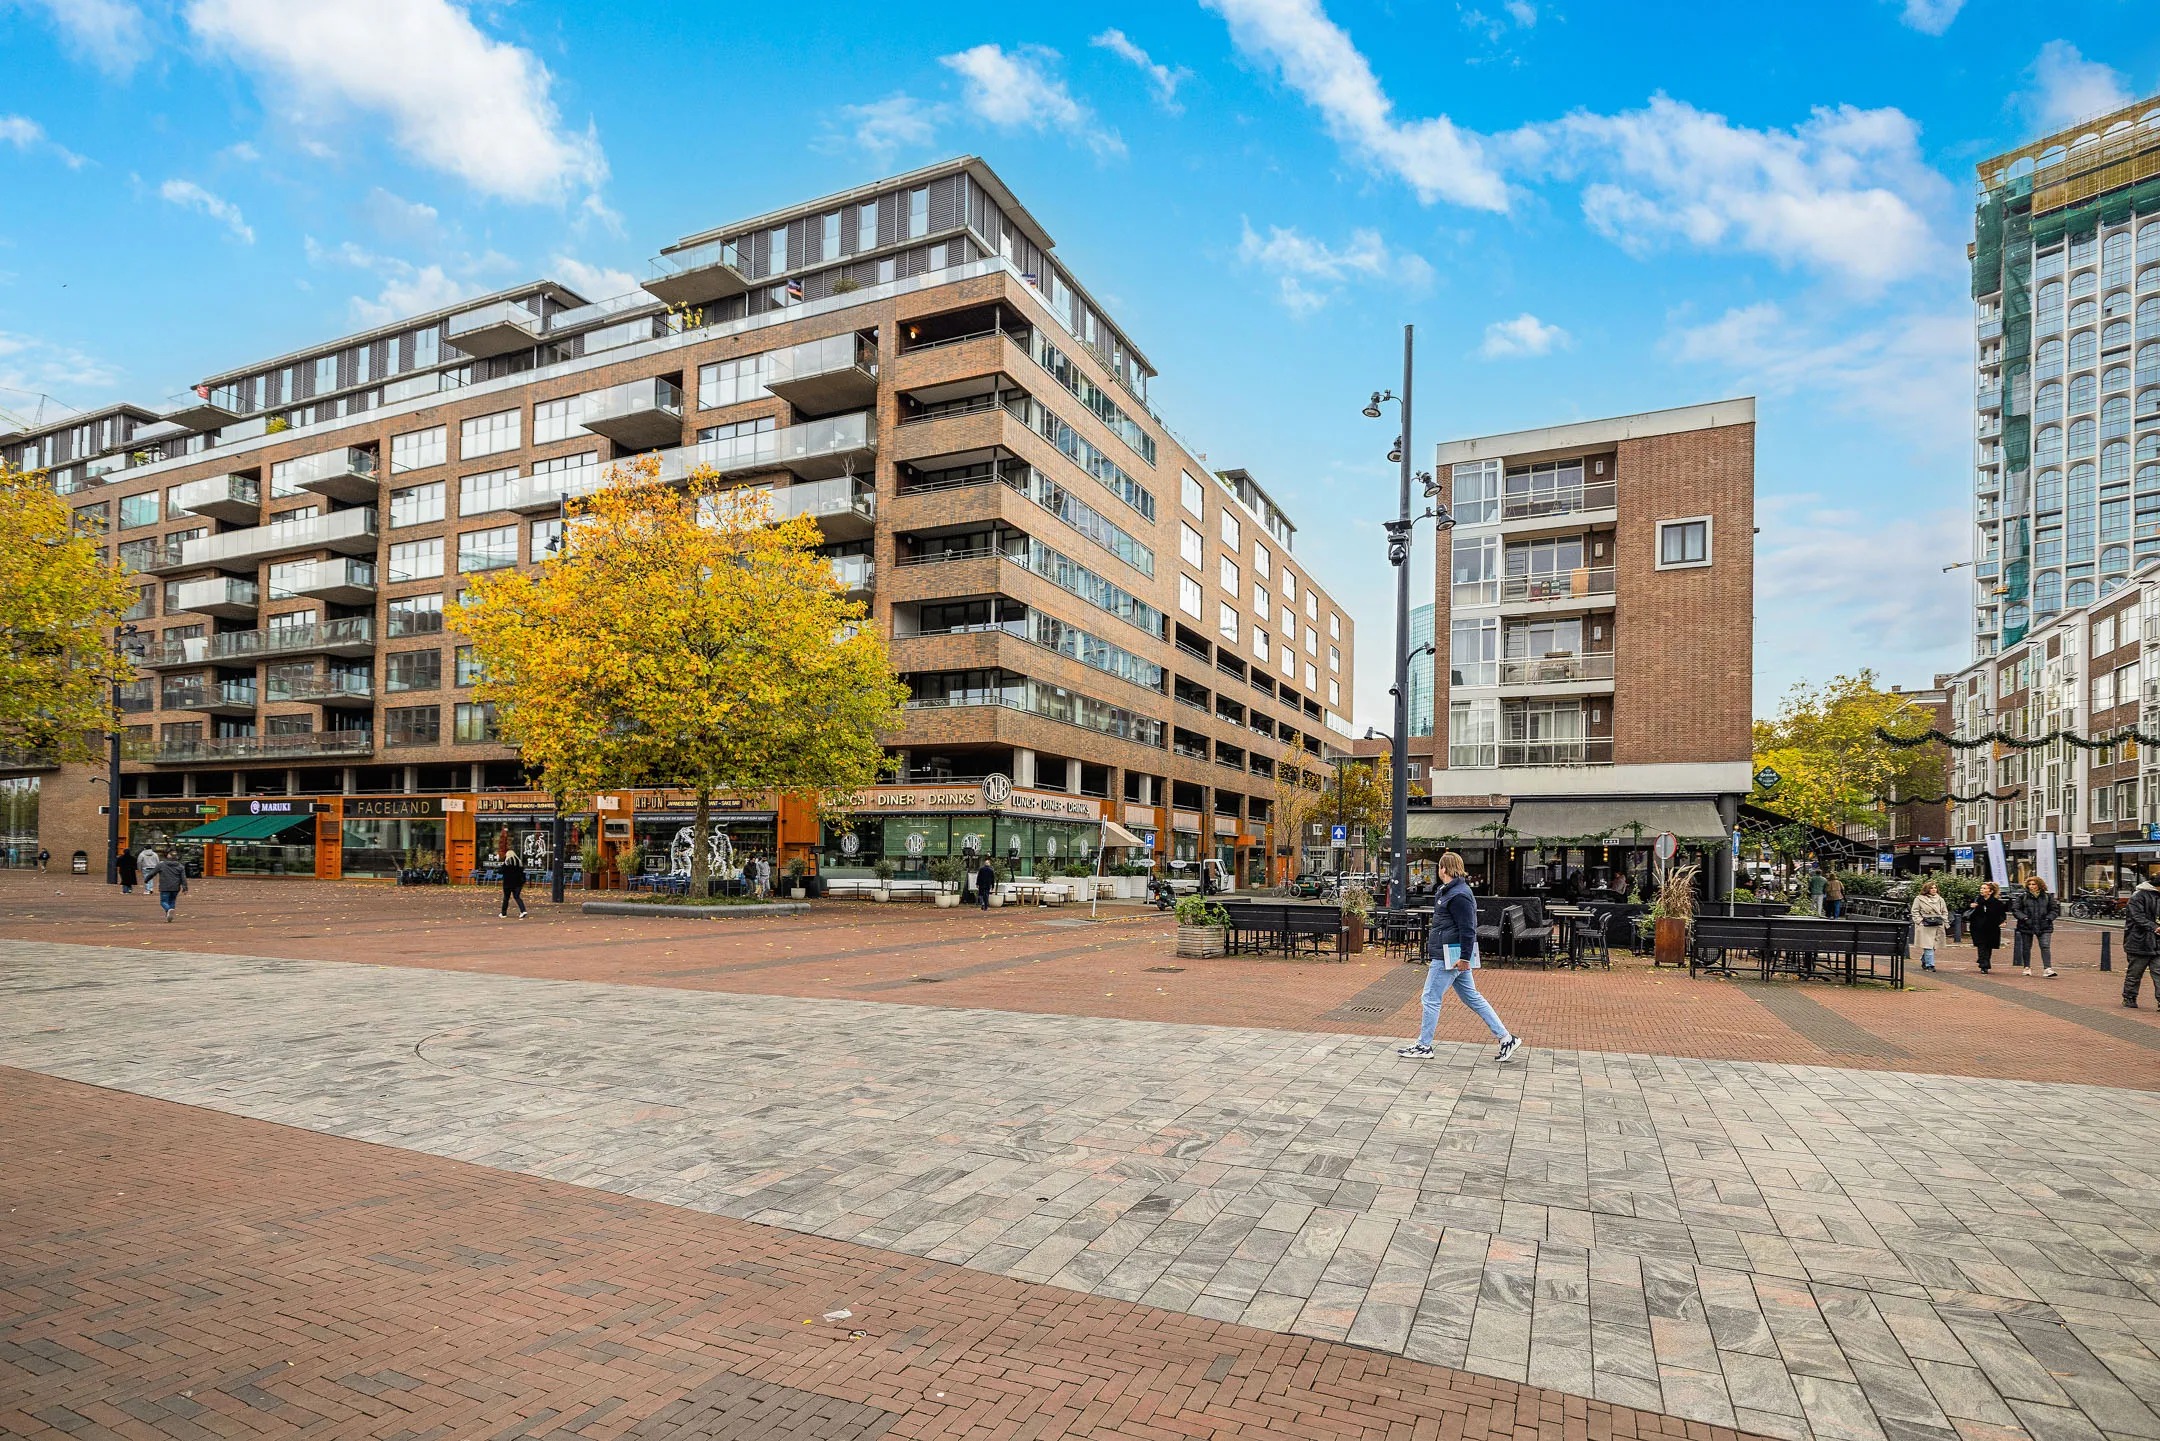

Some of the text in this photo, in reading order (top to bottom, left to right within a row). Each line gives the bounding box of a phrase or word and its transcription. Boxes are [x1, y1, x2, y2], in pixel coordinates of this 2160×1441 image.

[477, 799, 504, 811] AH-UN
[634, 797, 665, 809] AH-UN
[827, 793, 976, 806] LCH DINER DRINKS
[1011, 795, 1038, 809] LUNCH
[1041, 799, 1062, 812] DINER
[1067, 802, 1090, 814] DRINKS
[261, 802, 292, 812] MARUKI
[357, 801, 430, 814] FACELAND
[1147, 835, 1153, 843] P
